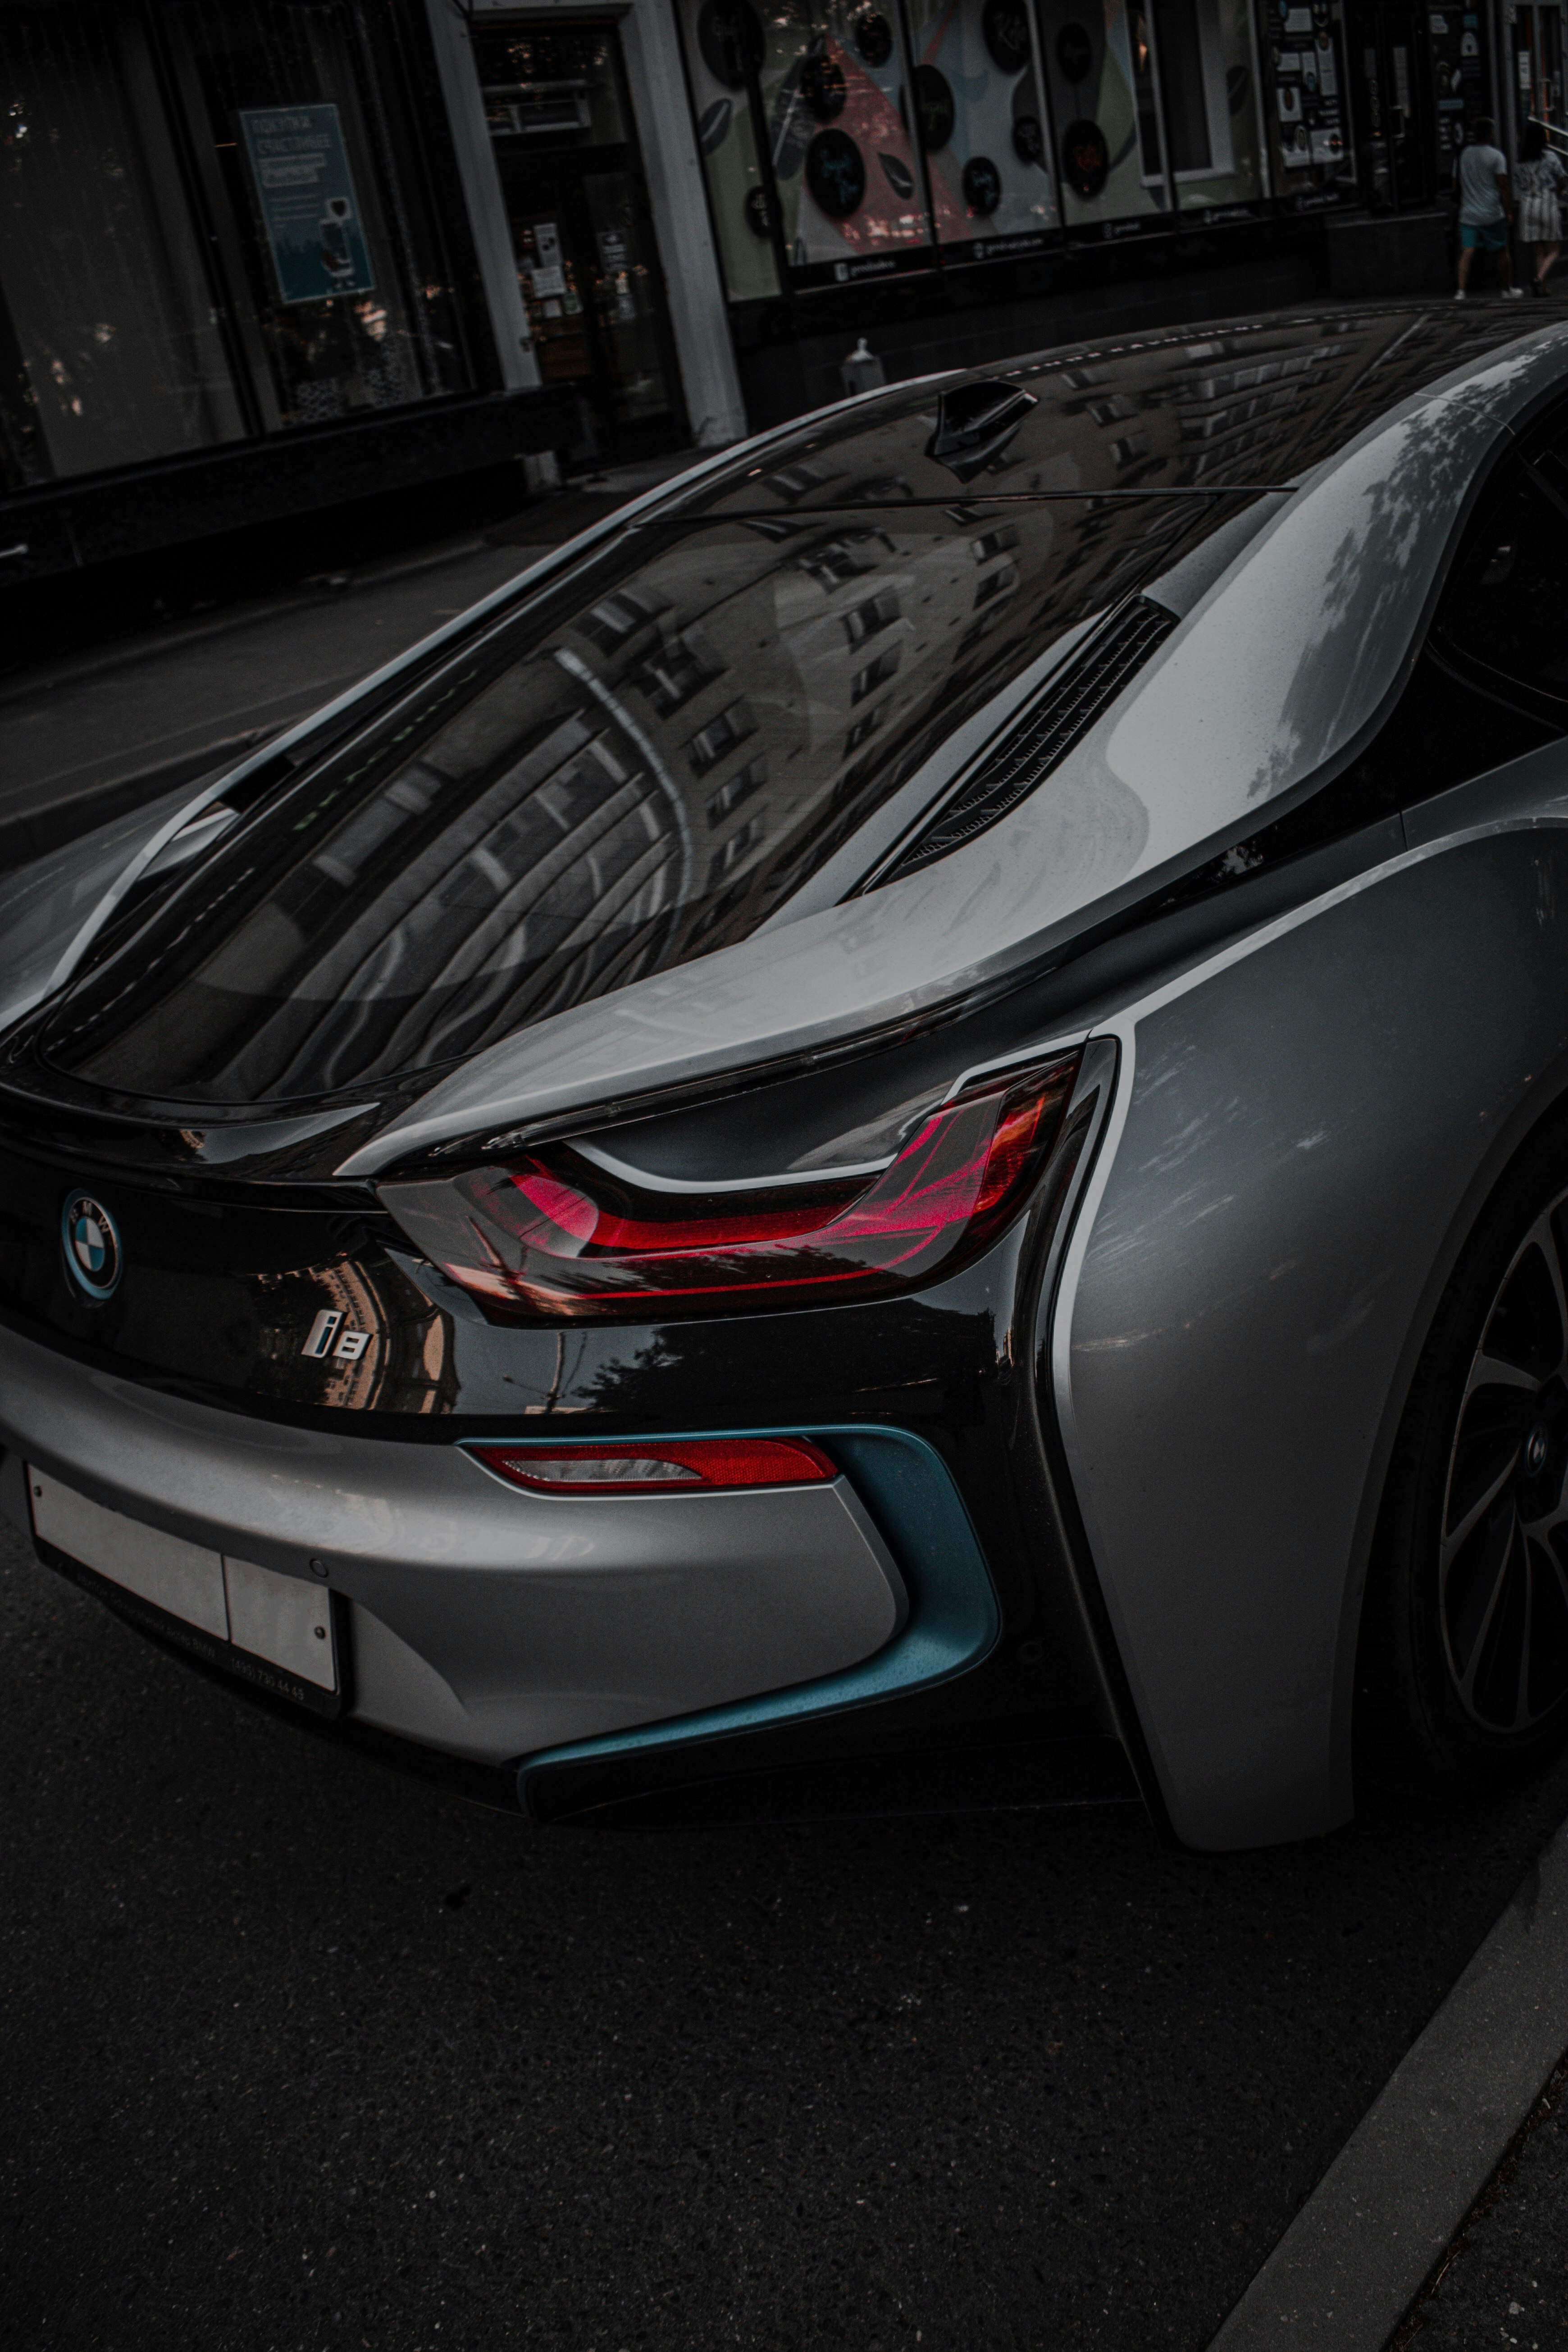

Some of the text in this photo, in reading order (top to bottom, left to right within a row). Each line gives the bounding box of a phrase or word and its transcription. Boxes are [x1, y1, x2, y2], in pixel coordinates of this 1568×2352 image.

[70, 1200, 111, 1233] BMW
[301, 1309, 373, 1360] i8
[276, 1678, 289, 1695] 44
